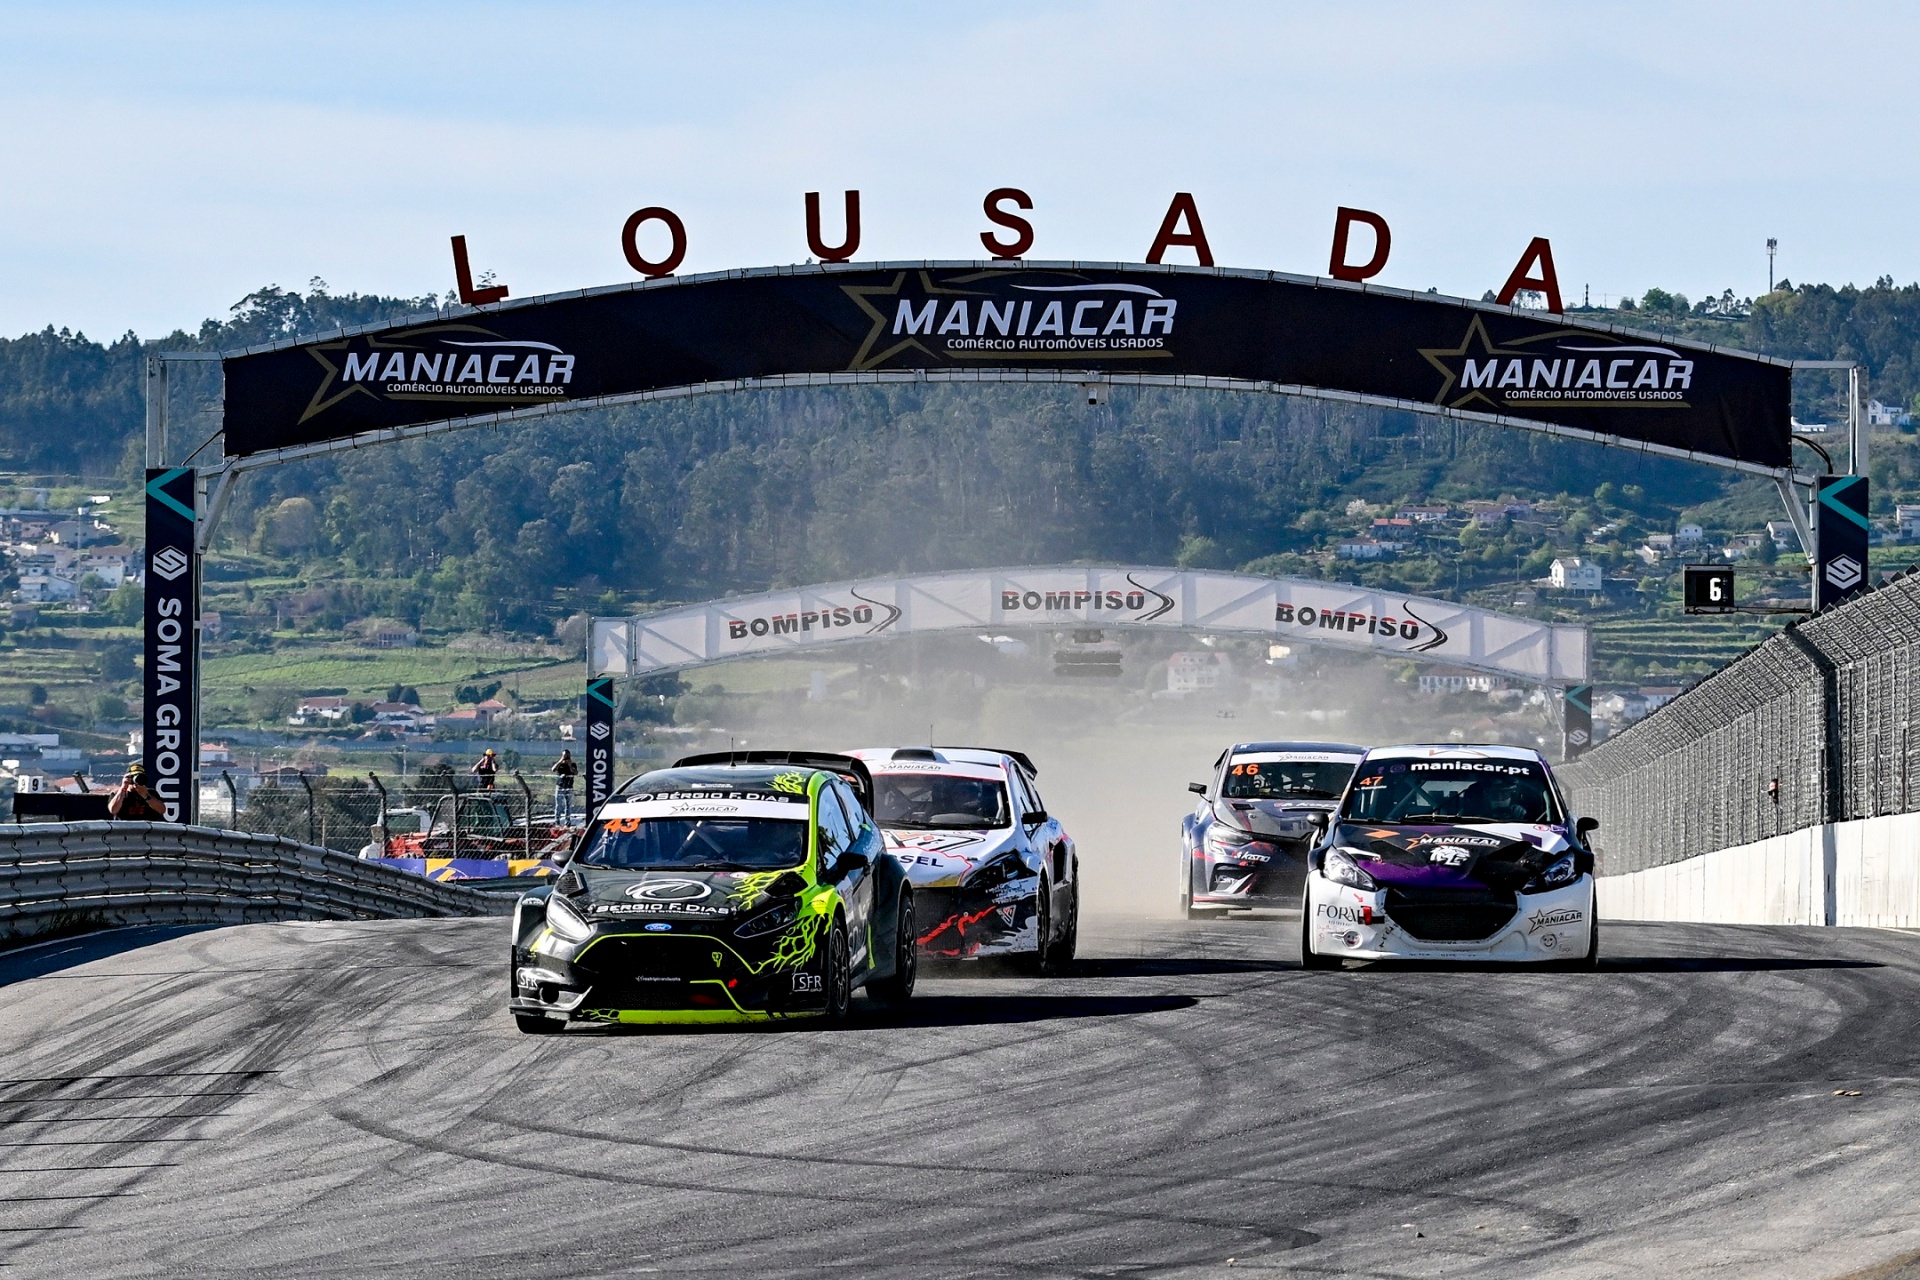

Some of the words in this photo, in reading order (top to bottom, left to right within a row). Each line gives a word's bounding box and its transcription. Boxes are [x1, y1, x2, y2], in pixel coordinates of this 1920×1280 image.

[452, 188, 1563, 314] LOUSADA
[892, 299, 1177, 336] MANIACAR
[947, 337, 1015, 349] COMÉRCIO
[1019, 337, 1107, 349] AUTOMÓVEIS
[1110, 338, 1164, 348] USADOS
[342, 352, 575, 384] MANIACAR
[1460, 359, 1694, 389] MANIACAR
[387, 381, 443, 393] COMÉRCIO
[446, 383, 517, 395] AUTOMÓVEIS
[520, 385, 564, 395] USADOS
[1505, 389, 1562, 399] COMÉRCIO
[1564, 389, 1636, 400] AUTOMÓVEIS
[1639, 391, 1683, 400] USADOS
[1709, 577, 1722, 601] 6
[156, 596, 182, 697] SOMA
[155, 703, 181, 822] GROUP
[1231, 763, 1259, 776] 46
[1410, 761, 1530, 775] maniacar.pt
[592, 748, 607, 803] SOMA
[1359, 776, 1384, 786] 47
[656, 791, 723, 800] SÉRGIO
[603, 817, 641, 834] 43
[1420, 837, 1500, 846] MANIACAR
[895, 854, 944, 868] SEL
[1537, 911, 1582, 926] MANIACAR
[799, 975, 822, 990] SFR
